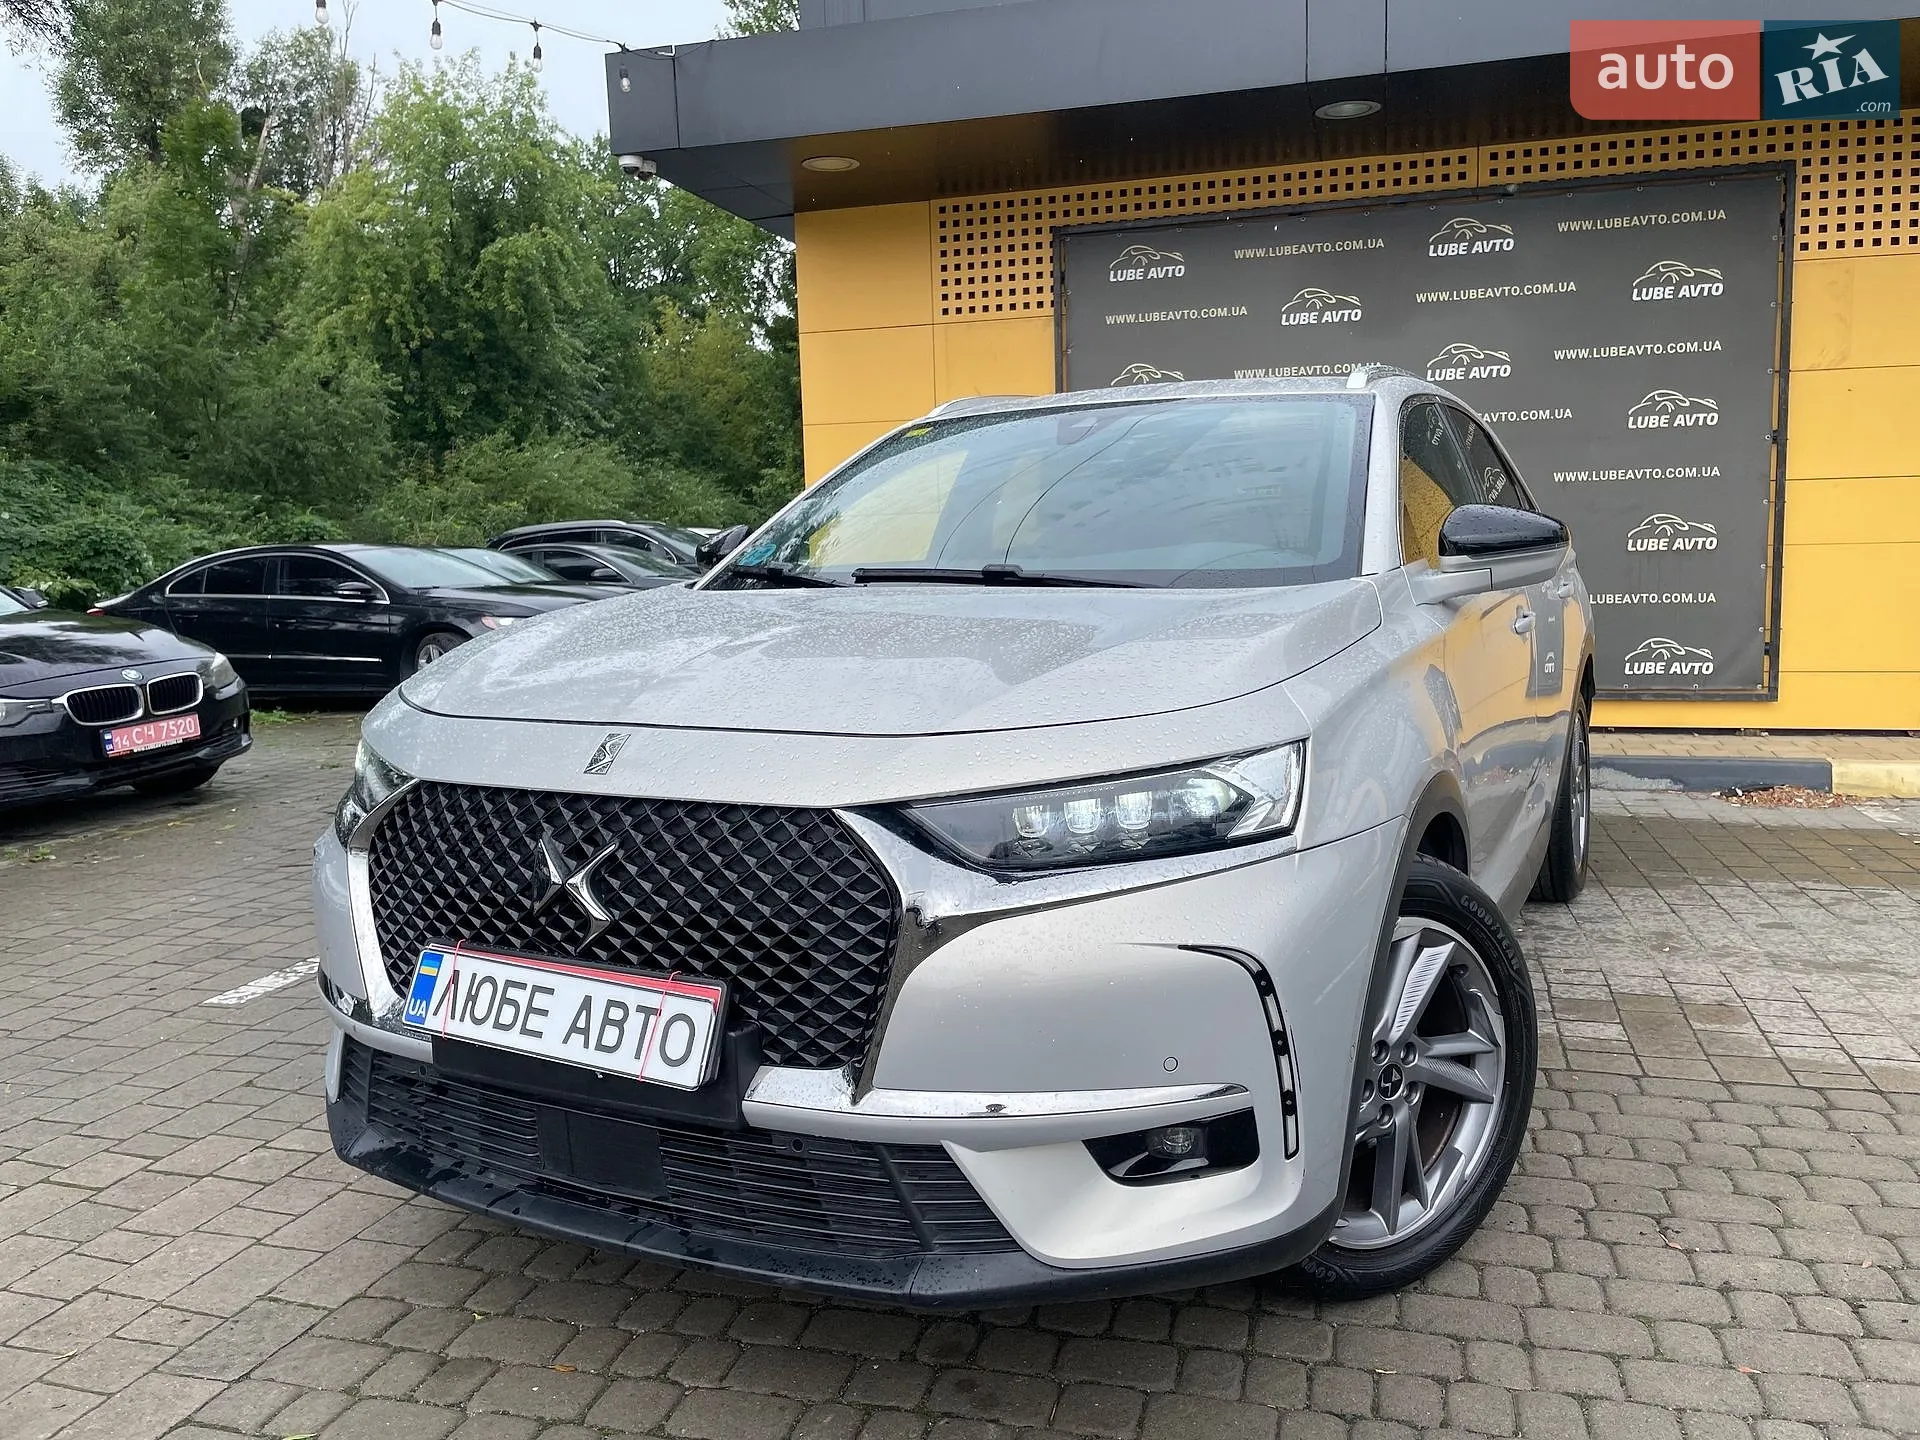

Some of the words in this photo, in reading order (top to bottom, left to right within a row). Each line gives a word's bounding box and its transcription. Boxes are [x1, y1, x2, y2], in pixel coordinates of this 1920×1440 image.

[1557, 209, 1726, 232] WWW.LUBEAVTO.COM.UA
[1234, 238, 1385, 259] WWW.LUBEAVTO.COM.UA
[1429, 243, 1468, 257] LUBE
[1472, 238, 1514, 255] AVTO
[1109, 267, 1144, 282] LUBE
[1147, 265, 1185, 280] AVTO
[1416, 281, 1577, 303] WWW.LUBEAVTO.COM.UA
[1632, 285, 1675, 301] LUBE
[1678, 282, 1724, 299] AVTO
[1105, 306, 1248, 325] WWW.LUBEAVTO.COM.UA
[1281, 311, 1318, 326] LUBE
[1321, 308, 1362, 324] AVTO
[1554, 340, 1722, 360] WWW.LUBEAVTO.COM.UA
[1426, 367, 1465, 382] LUBE
[1468, 364, 1512, 380] AVTO
[1477, 408, 1573, 423] AVTO.COM.UA
[1627, 415, 1669, 429] LUBE
[1673, 412, 1719, 428] AVTO
[1553, 466, 1721, 483] WWW.LUBEAVTO.COM.UA
[1627, 538, 1669, 552] LUBE
[1673, 536, 1718, 551] AVTO
[1624, 661, 1666, 675] LUBE
[1669, 660, 1714, 675] AVTO
[114, 735, 130, 749] 14
[159, 717, 195, 740] 7520
[407, 997, 427, 1019] UA
[432, 969, 555, 1039] ЛЮБЕ
[561, 994, 696, 1068] АВТО
